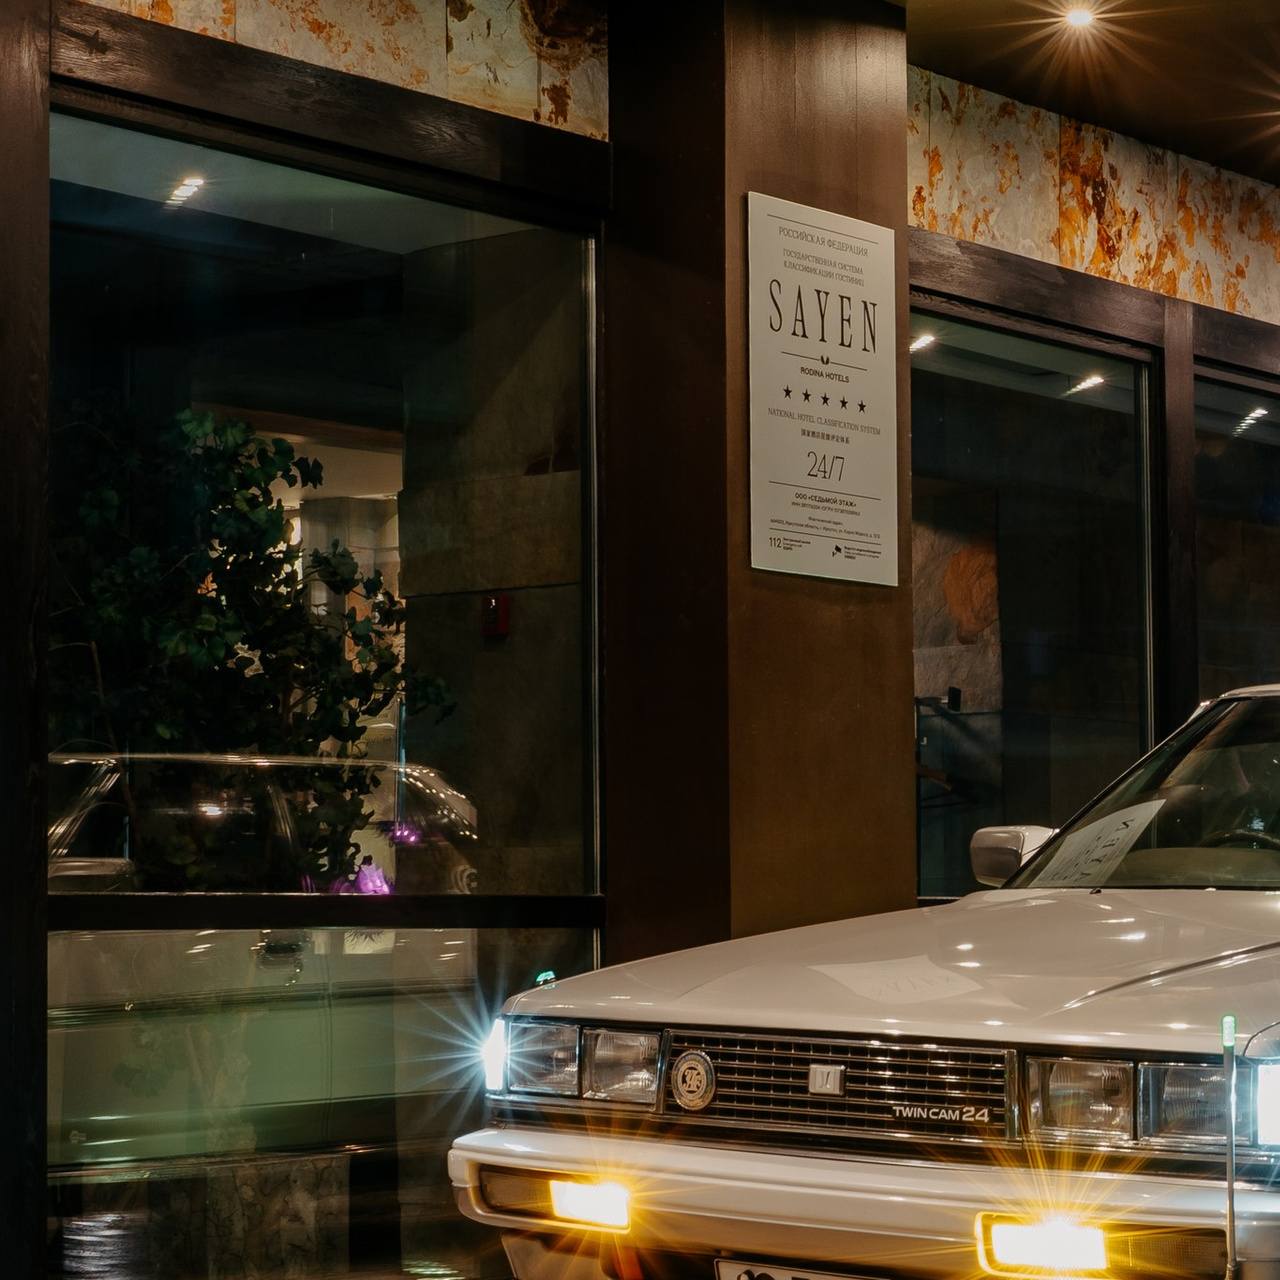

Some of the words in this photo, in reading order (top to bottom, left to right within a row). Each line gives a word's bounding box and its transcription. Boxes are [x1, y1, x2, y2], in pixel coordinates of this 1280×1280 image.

[779, 226, 825, 247] РОССИЙСКАЯ
[827, 238, 868, 258] ФЕДЕРАЦИЯ
[783, 249, 836, 269] ГОСУДАРСТВЕННАЯ
[838, 262, 864, 275] СИСТЕМА
[784, 261, 834, 280] КЛАССИФИКАЦИИ
[835, 273, 864, 287] ГОСТИНИЦ
[770, 278, 878, 354] SAYEN
[801, 367, 824, 378] RODINA
[826, 372, 849, 383] HOTELS
[768, 408, 795, 419] NATIONAL
[798, 413, 814, 422] HOTEL
[817, 417, 859, 431] CLASSIFICATION
[860, 425, 881, 435] SYSTEM
[807, 450, 845, 482] 24/7
[769, 537, 781, 548] 112
[892, 1106, 927, 1119] TWIN
[929, 1108, 960, 1121] CAM
[962, 1106, 990, 1123] 24
